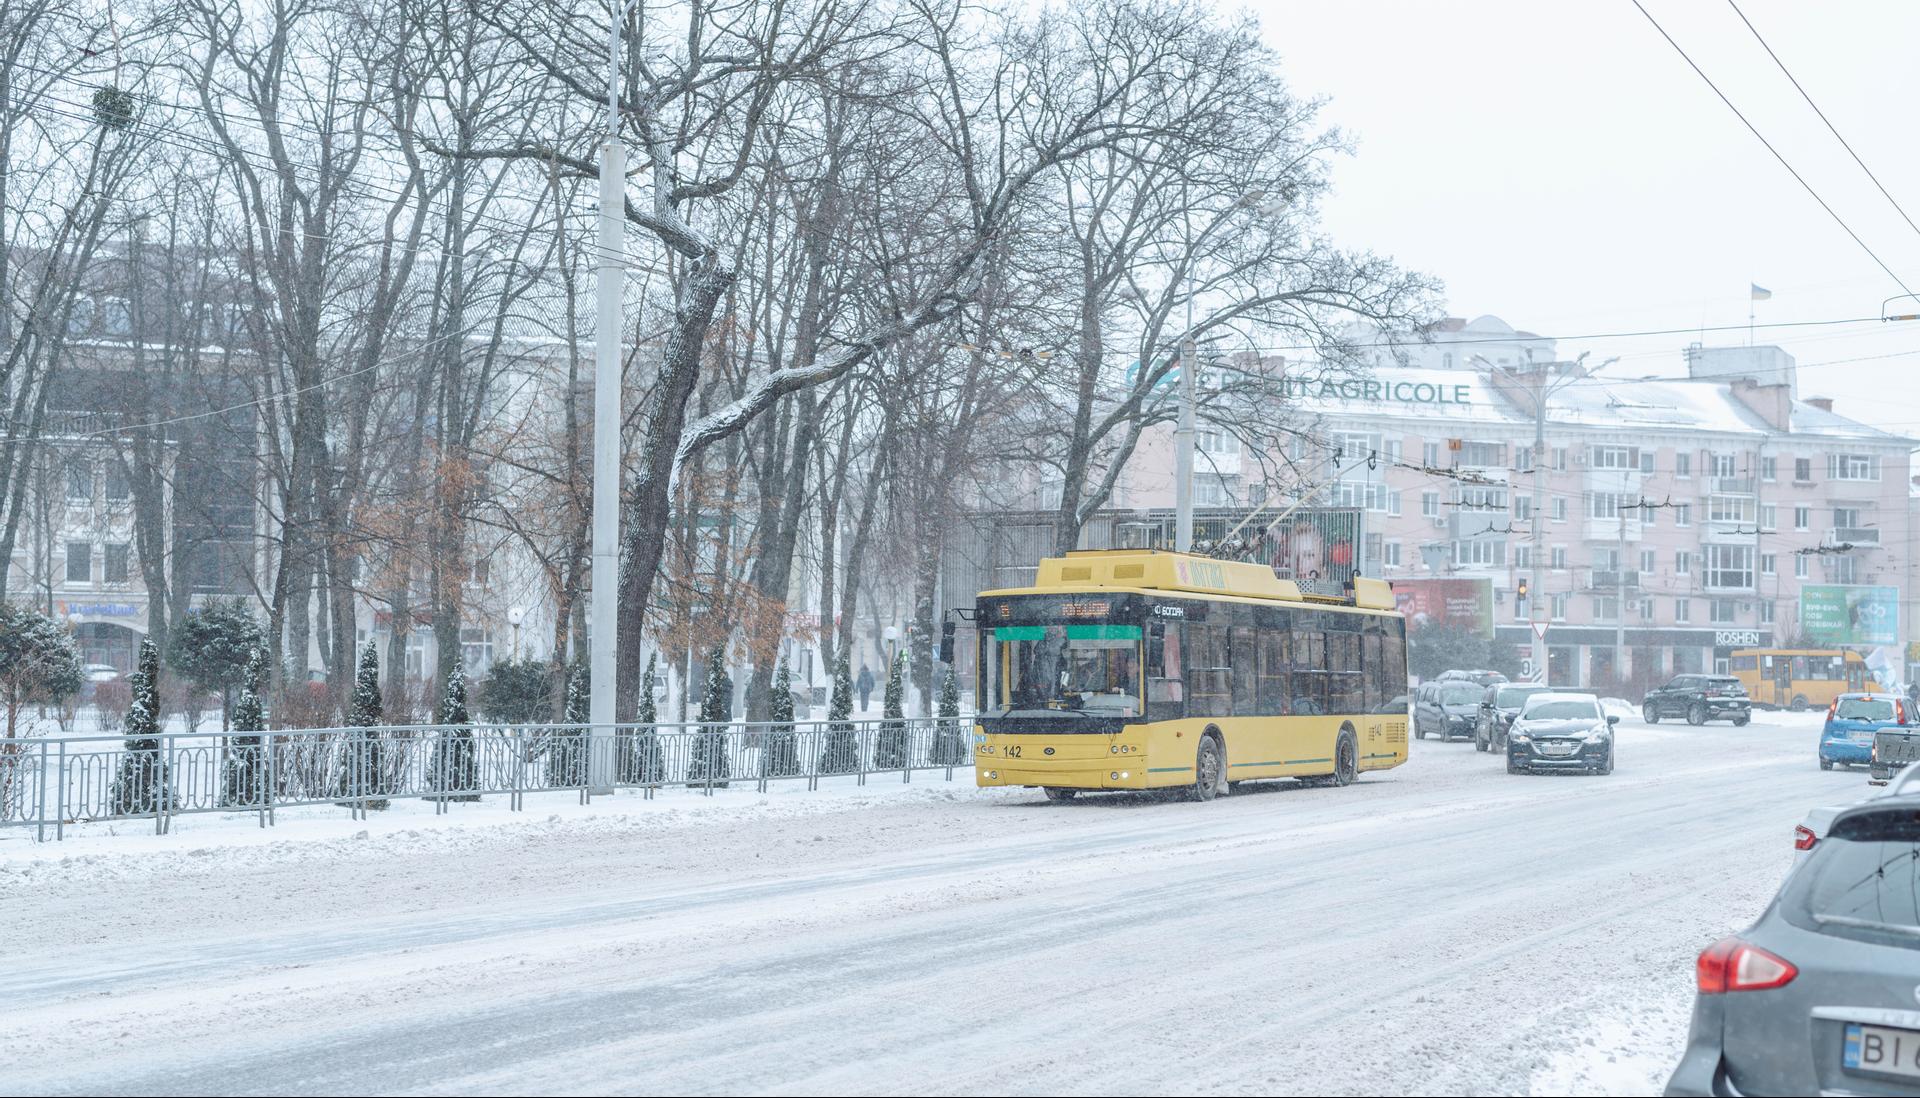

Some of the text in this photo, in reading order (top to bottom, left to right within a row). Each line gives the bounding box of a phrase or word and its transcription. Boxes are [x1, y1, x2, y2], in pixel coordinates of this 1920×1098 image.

[1319, 377, 1472, 404] AGRICOLE
[1715, 631, 1759, 645] ROSHEN
[1003, 745, 1022, 758] 142
